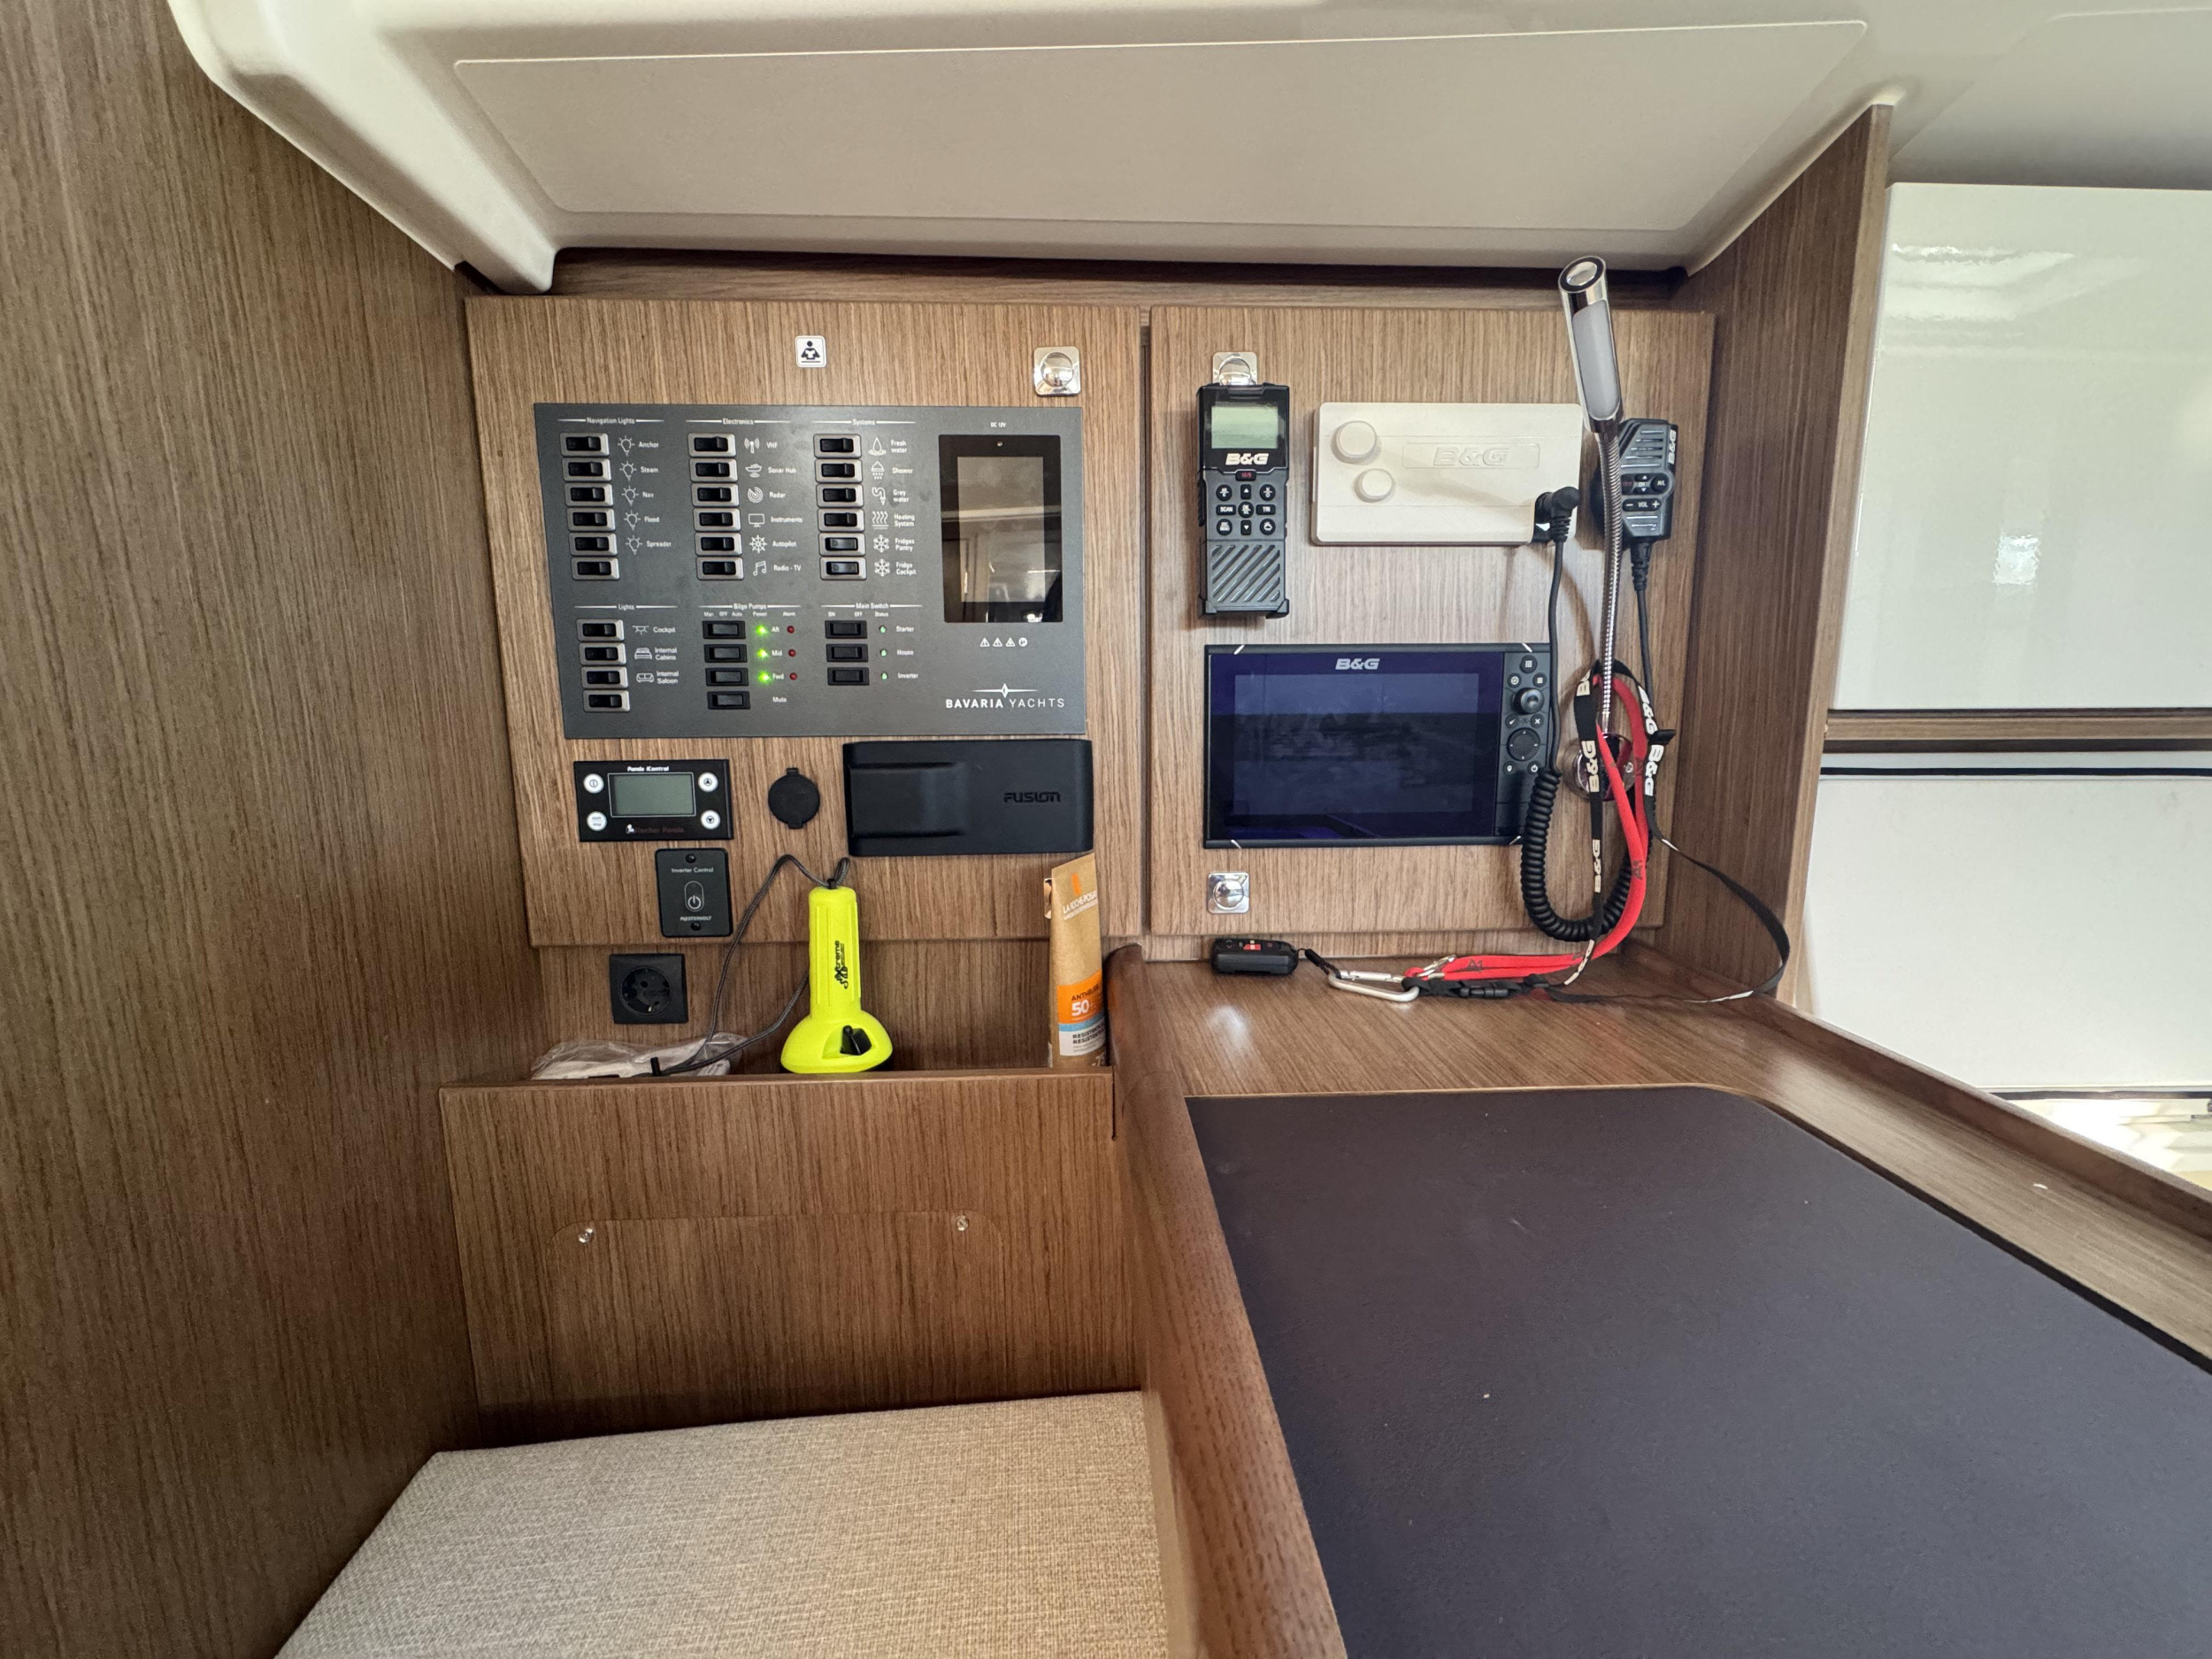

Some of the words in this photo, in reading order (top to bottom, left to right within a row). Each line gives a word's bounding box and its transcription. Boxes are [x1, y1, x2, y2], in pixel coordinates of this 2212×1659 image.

[1225, 453, 1269, 465] B&G
[1433, 447, 1509, 466] B&G
[733, 603, 748, 611] Bilge
[1334, 657, 1380, 671] B&G
[945, 698, 1003, 709] BAVARIA
[1009, 698, 1065, 708] YACHTS
[1581, 740, 1600, 793] B&G
[1644, 744, 1664, 796] B&G
[1071, 999, 1089, 1017] 50
